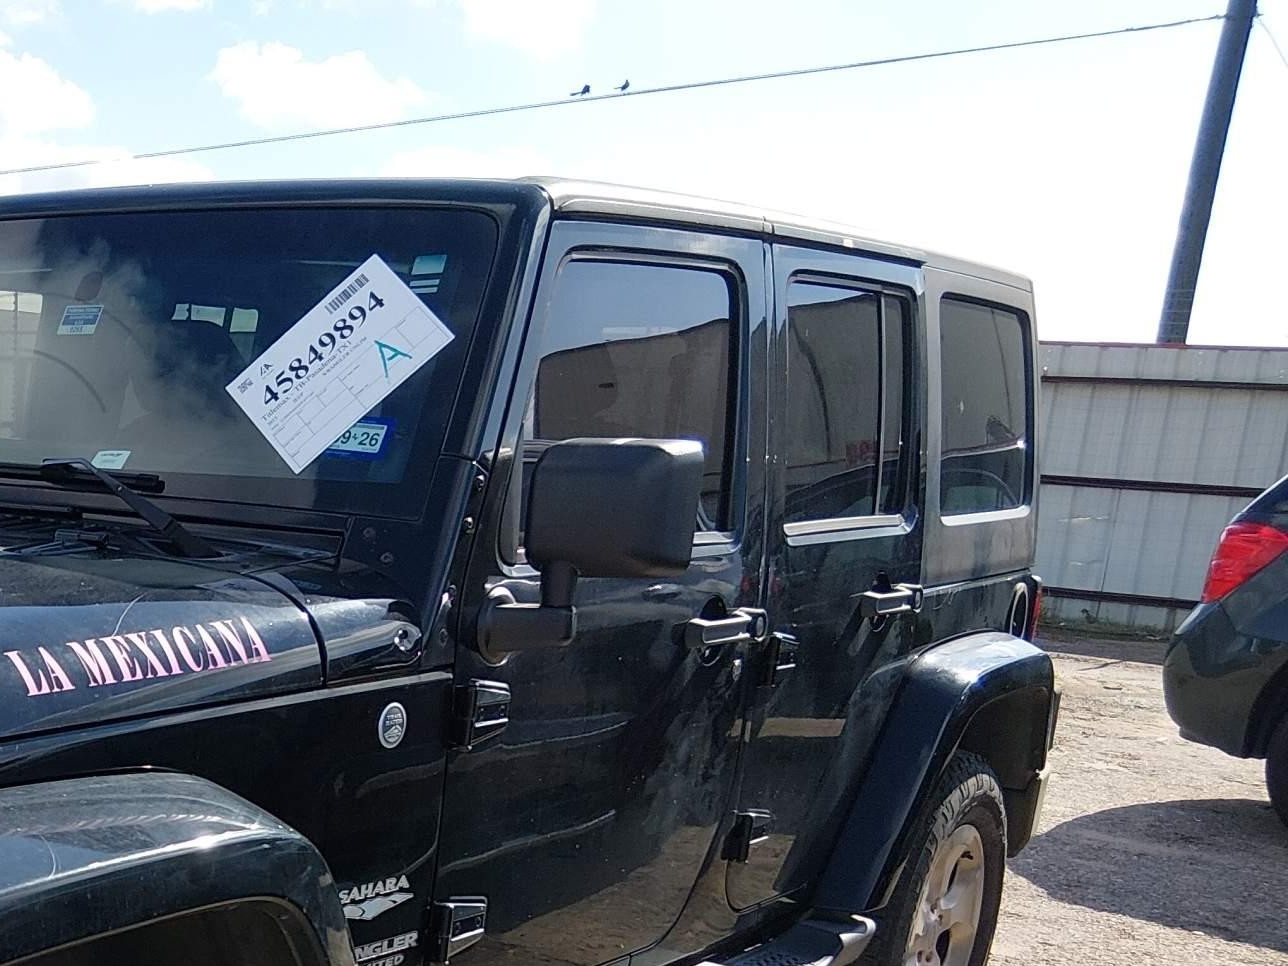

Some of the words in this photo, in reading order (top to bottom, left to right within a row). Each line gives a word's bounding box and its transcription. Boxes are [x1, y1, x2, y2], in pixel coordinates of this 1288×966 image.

[263, 291, 385, 406] 45849894
[374, 340, 413, 381] A
[4, 647, 75, 697] LA
[66, 616, 272, 688] MEXICANA
[338, 874, 410, 905] SAHARA
[354, 930, 419, 962] NGLER
